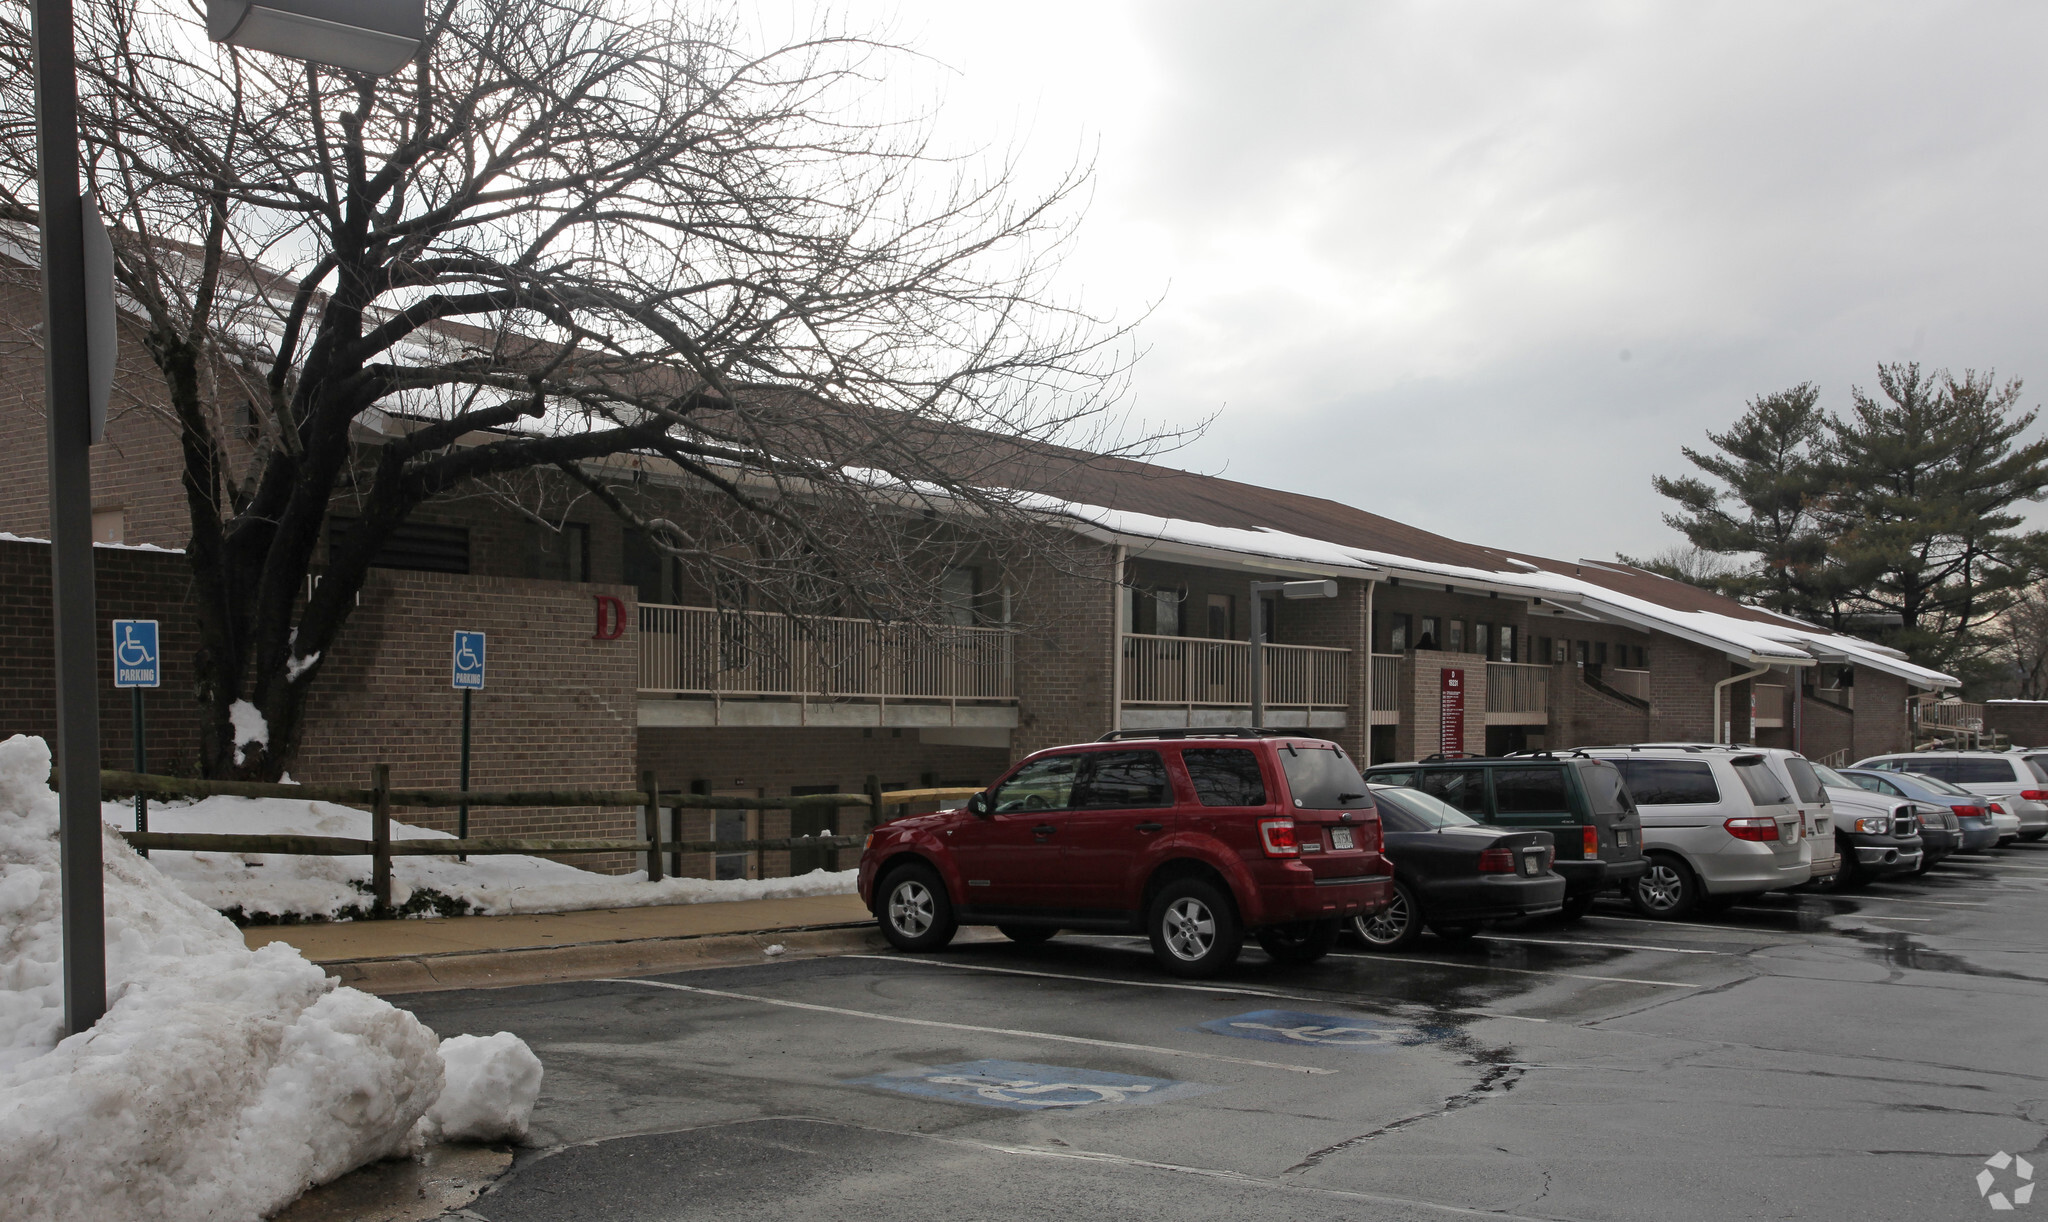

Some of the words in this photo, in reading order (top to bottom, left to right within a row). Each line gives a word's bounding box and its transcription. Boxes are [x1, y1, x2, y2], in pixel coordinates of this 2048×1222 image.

[592, 595, 627, 640] D
[120, 669, 154, 681] PARKING
[456, 673, 481, 684] PARKING
